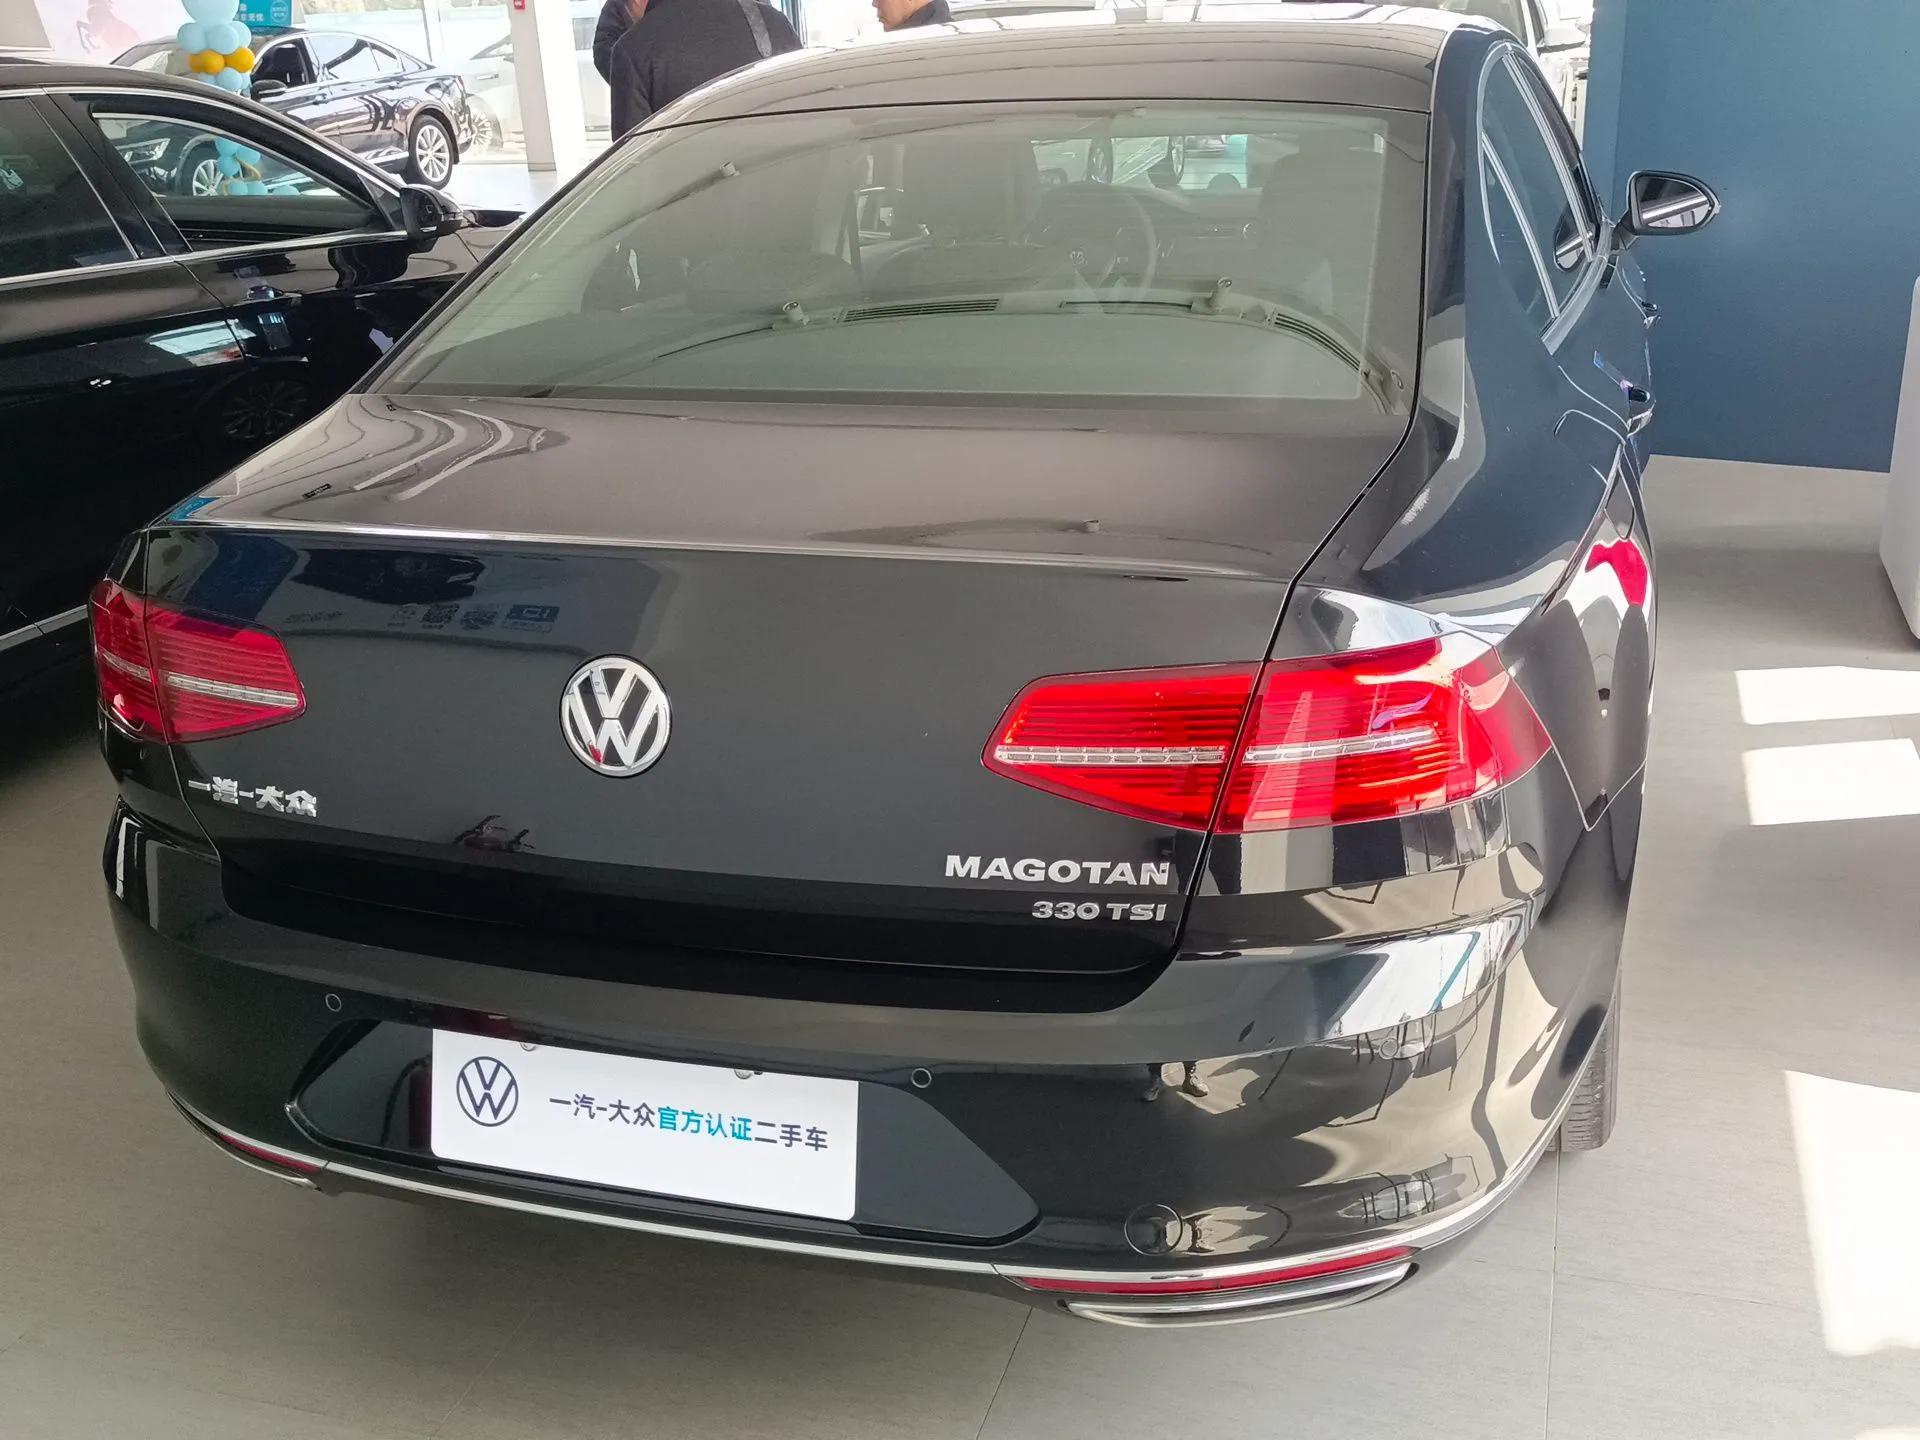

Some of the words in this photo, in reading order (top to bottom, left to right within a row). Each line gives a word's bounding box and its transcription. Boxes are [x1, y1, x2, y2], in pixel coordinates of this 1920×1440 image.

[188, 776, 317, 818] 一汽-大众
[945, 854, 1170, 886] MAGOTAN
[1031, 900, 1100, 920] 330
[1106, 903, 1167, 922] TSI
[549, 1093, 828, 1151] 一汽-大众官方认证二手车
